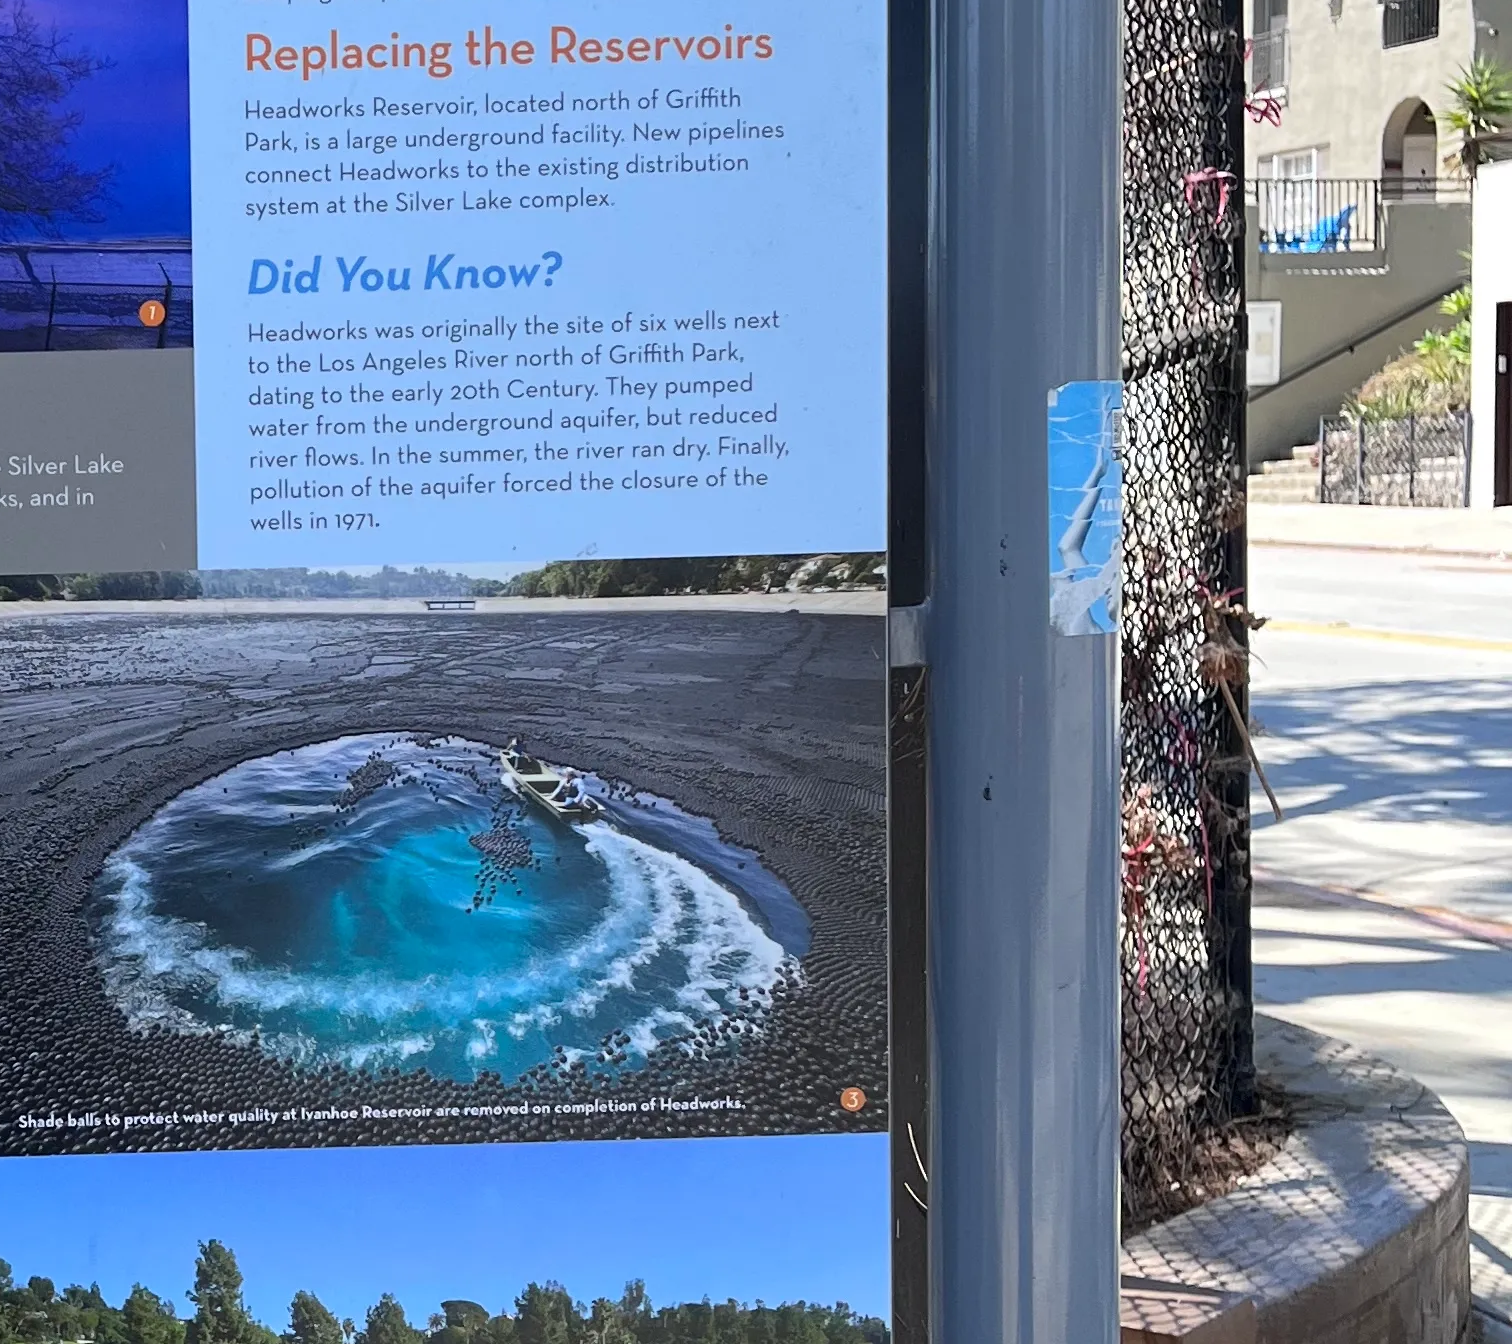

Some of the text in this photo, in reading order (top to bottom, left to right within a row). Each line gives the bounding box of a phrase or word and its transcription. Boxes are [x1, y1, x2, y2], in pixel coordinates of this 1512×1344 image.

[246, 23, 773, 81] Replacing the Reservoirs
[244, 86, 741, 120] Headworks Reservoir, located north of Griffith
[245, 186, 615, 222] system at the Silver Lake complex.
[247, 250, 563, 295] Did You Know?
[149, 306, 156, 320] 1
[18, 1095, 747, 1130] Shade balls to protect water quality at Ivanhoe Reservoir are removed on completion of Headworks.
[846, 1091, 859, 1108] 3
